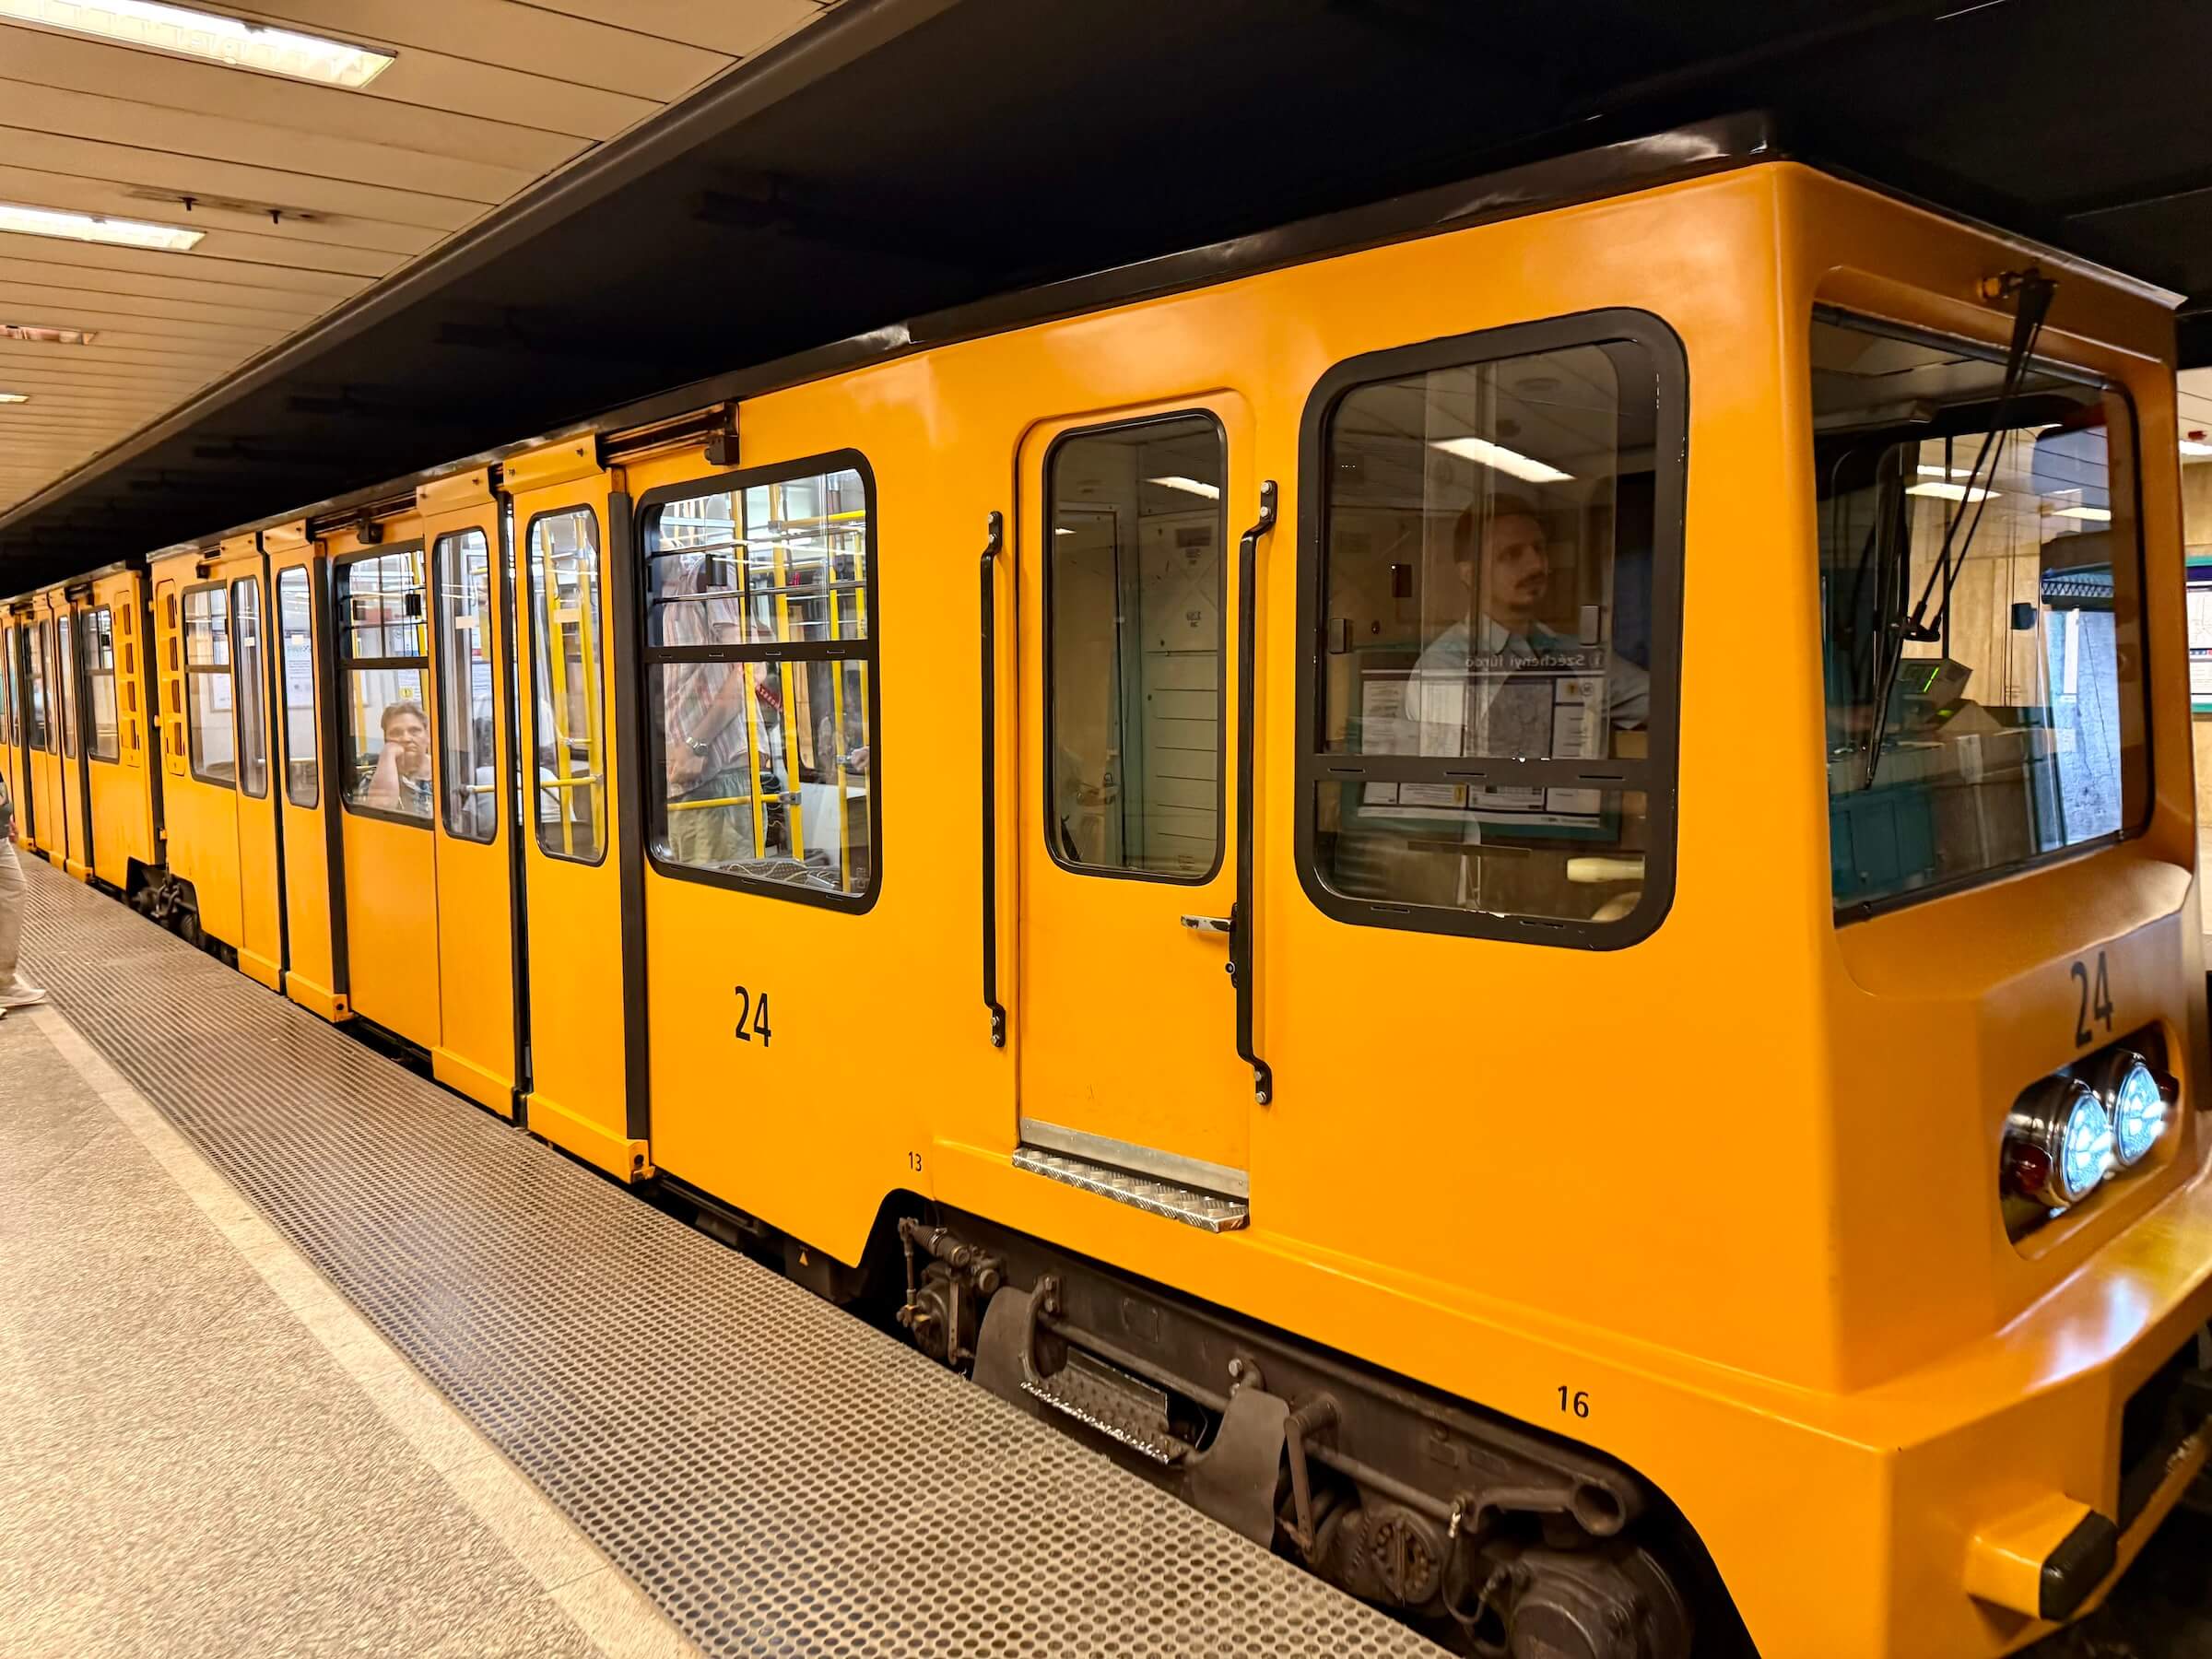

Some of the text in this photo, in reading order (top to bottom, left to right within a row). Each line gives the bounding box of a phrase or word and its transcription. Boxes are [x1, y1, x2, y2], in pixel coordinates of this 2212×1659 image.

[735, 985, 771, 1047] 24
[2071, 951, 2113, 1049] 24
[908, 1151, 922, 1171] 13
[1558, 1385, 1589, 1418] 16
